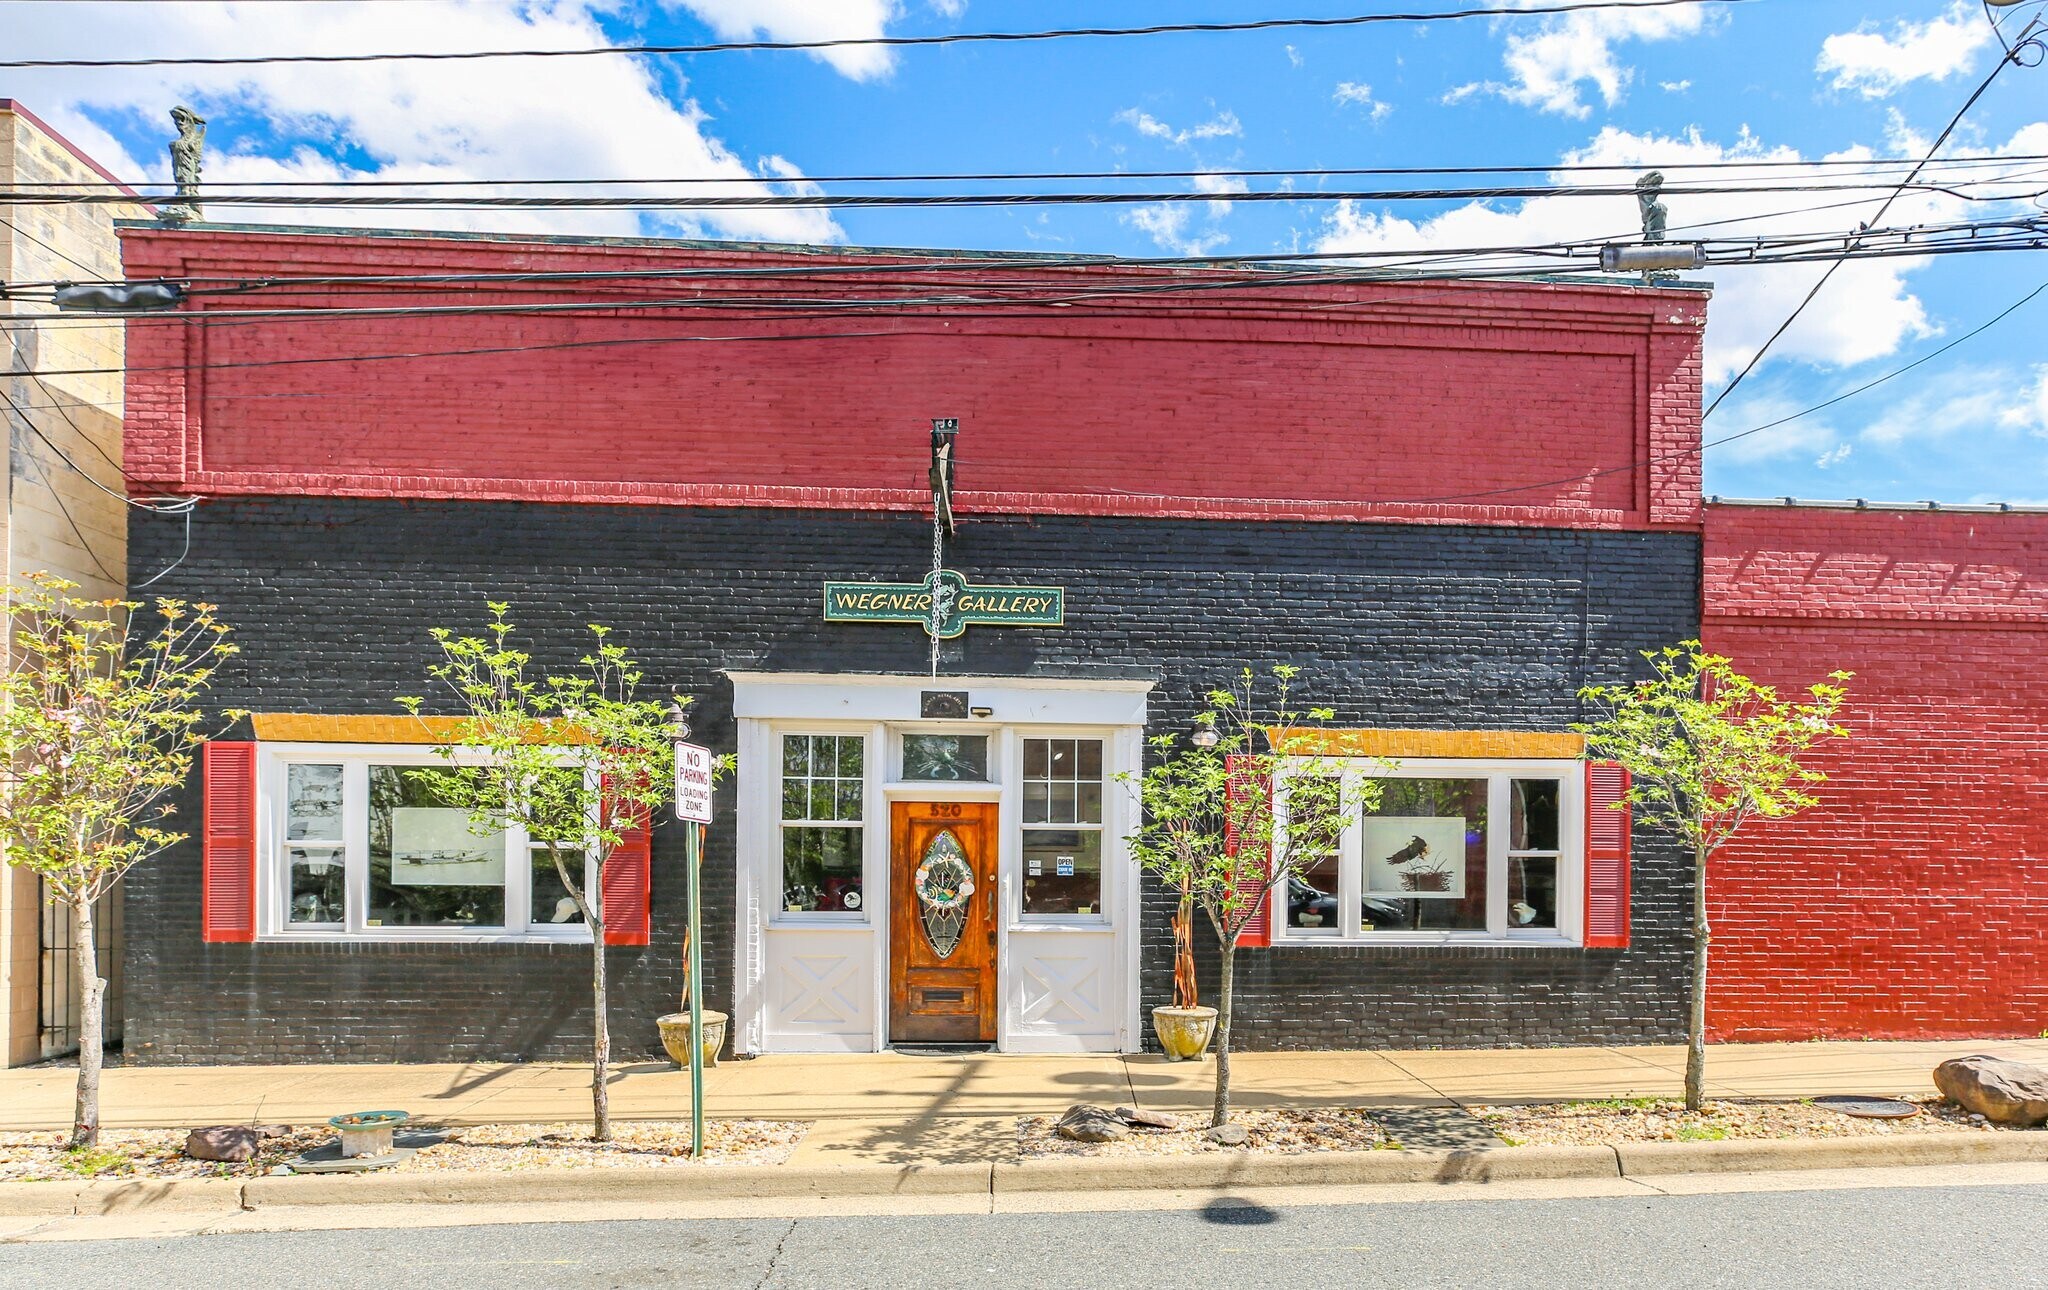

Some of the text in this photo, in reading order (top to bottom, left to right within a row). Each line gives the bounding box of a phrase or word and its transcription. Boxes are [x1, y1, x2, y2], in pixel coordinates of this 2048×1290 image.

[836, 593, 1052, 613] WEGNER GALLERY
[687, 752, 700, 767] NO
[680, 767, 708, 785] PARKING
[680, 787, 708, 800] LOADING
[686, 801, 703, 812] ZONE
[931, 804, 961, 817] 520
